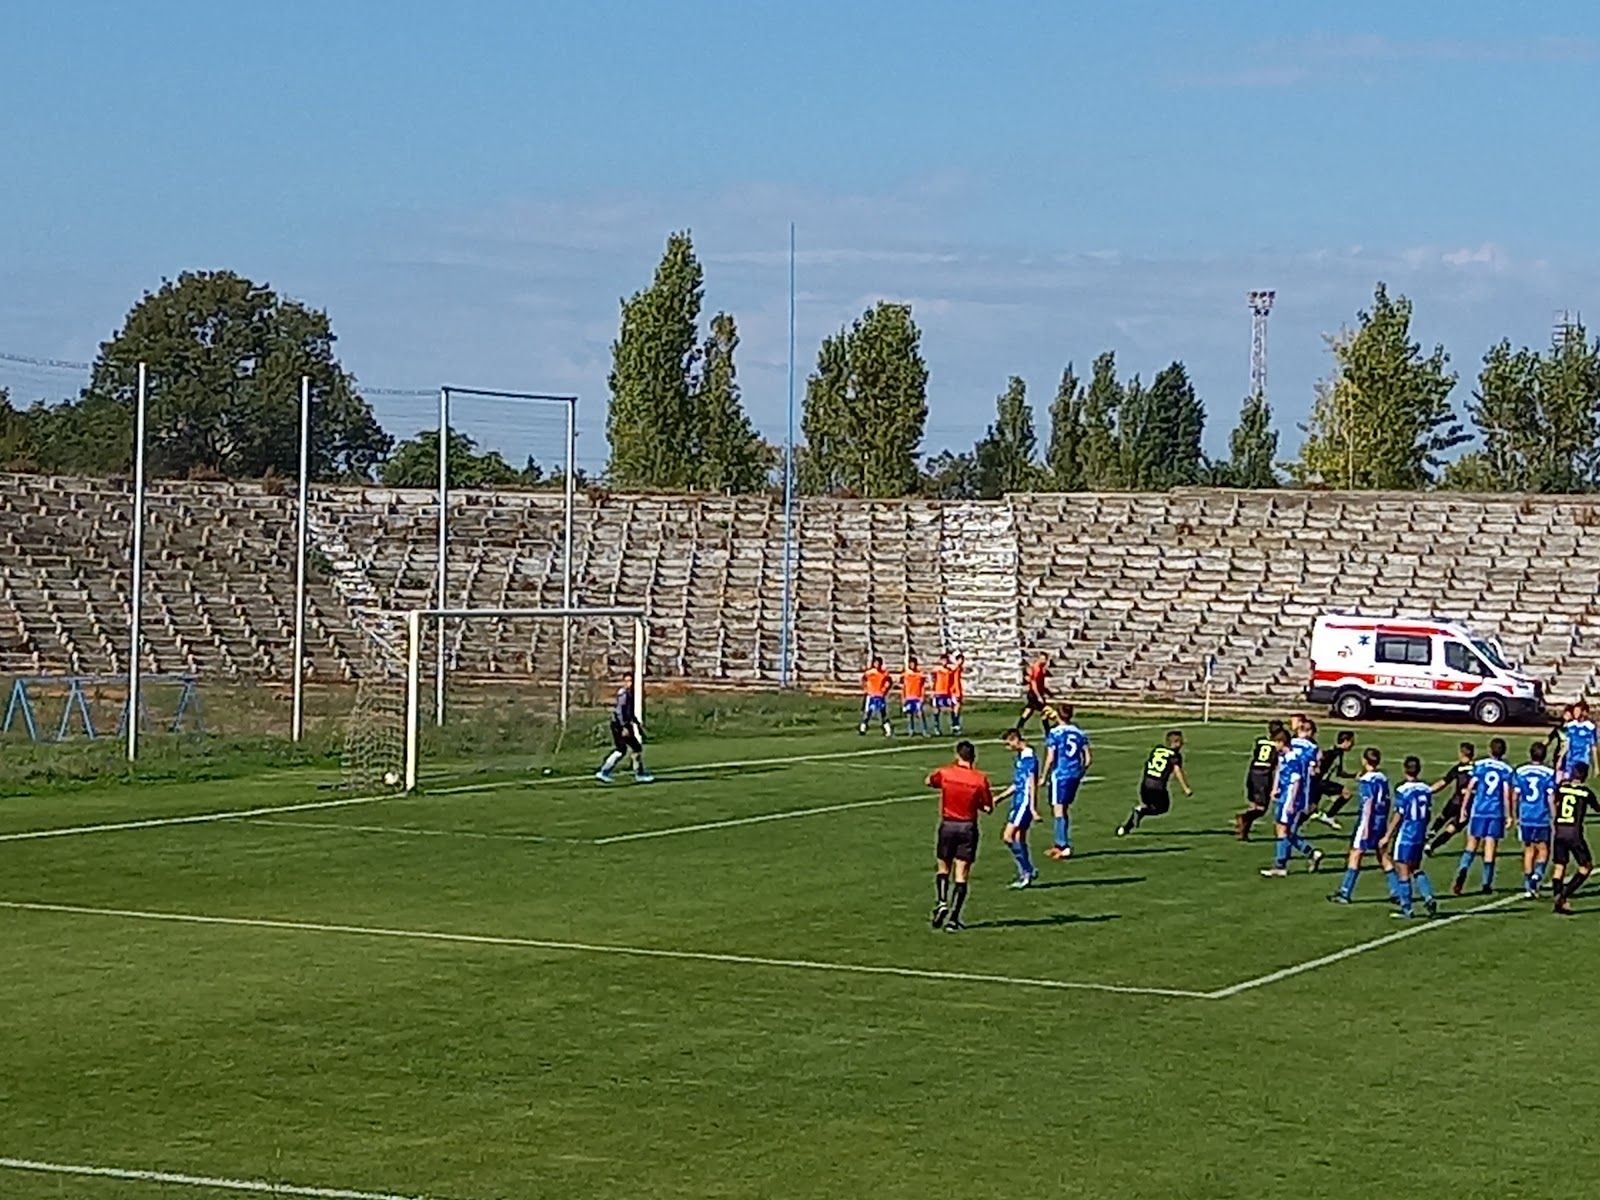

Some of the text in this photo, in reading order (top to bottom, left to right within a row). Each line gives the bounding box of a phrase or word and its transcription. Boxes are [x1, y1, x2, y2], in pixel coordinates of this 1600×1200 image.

[1065, 733, 1077, 758] 5
[1258, 744, 1272, 762] 8
[1484, 770, 1500, 796] 9
[1525, 776, 1540, 802] 3
[1561, 794, 1577, 818] 6
